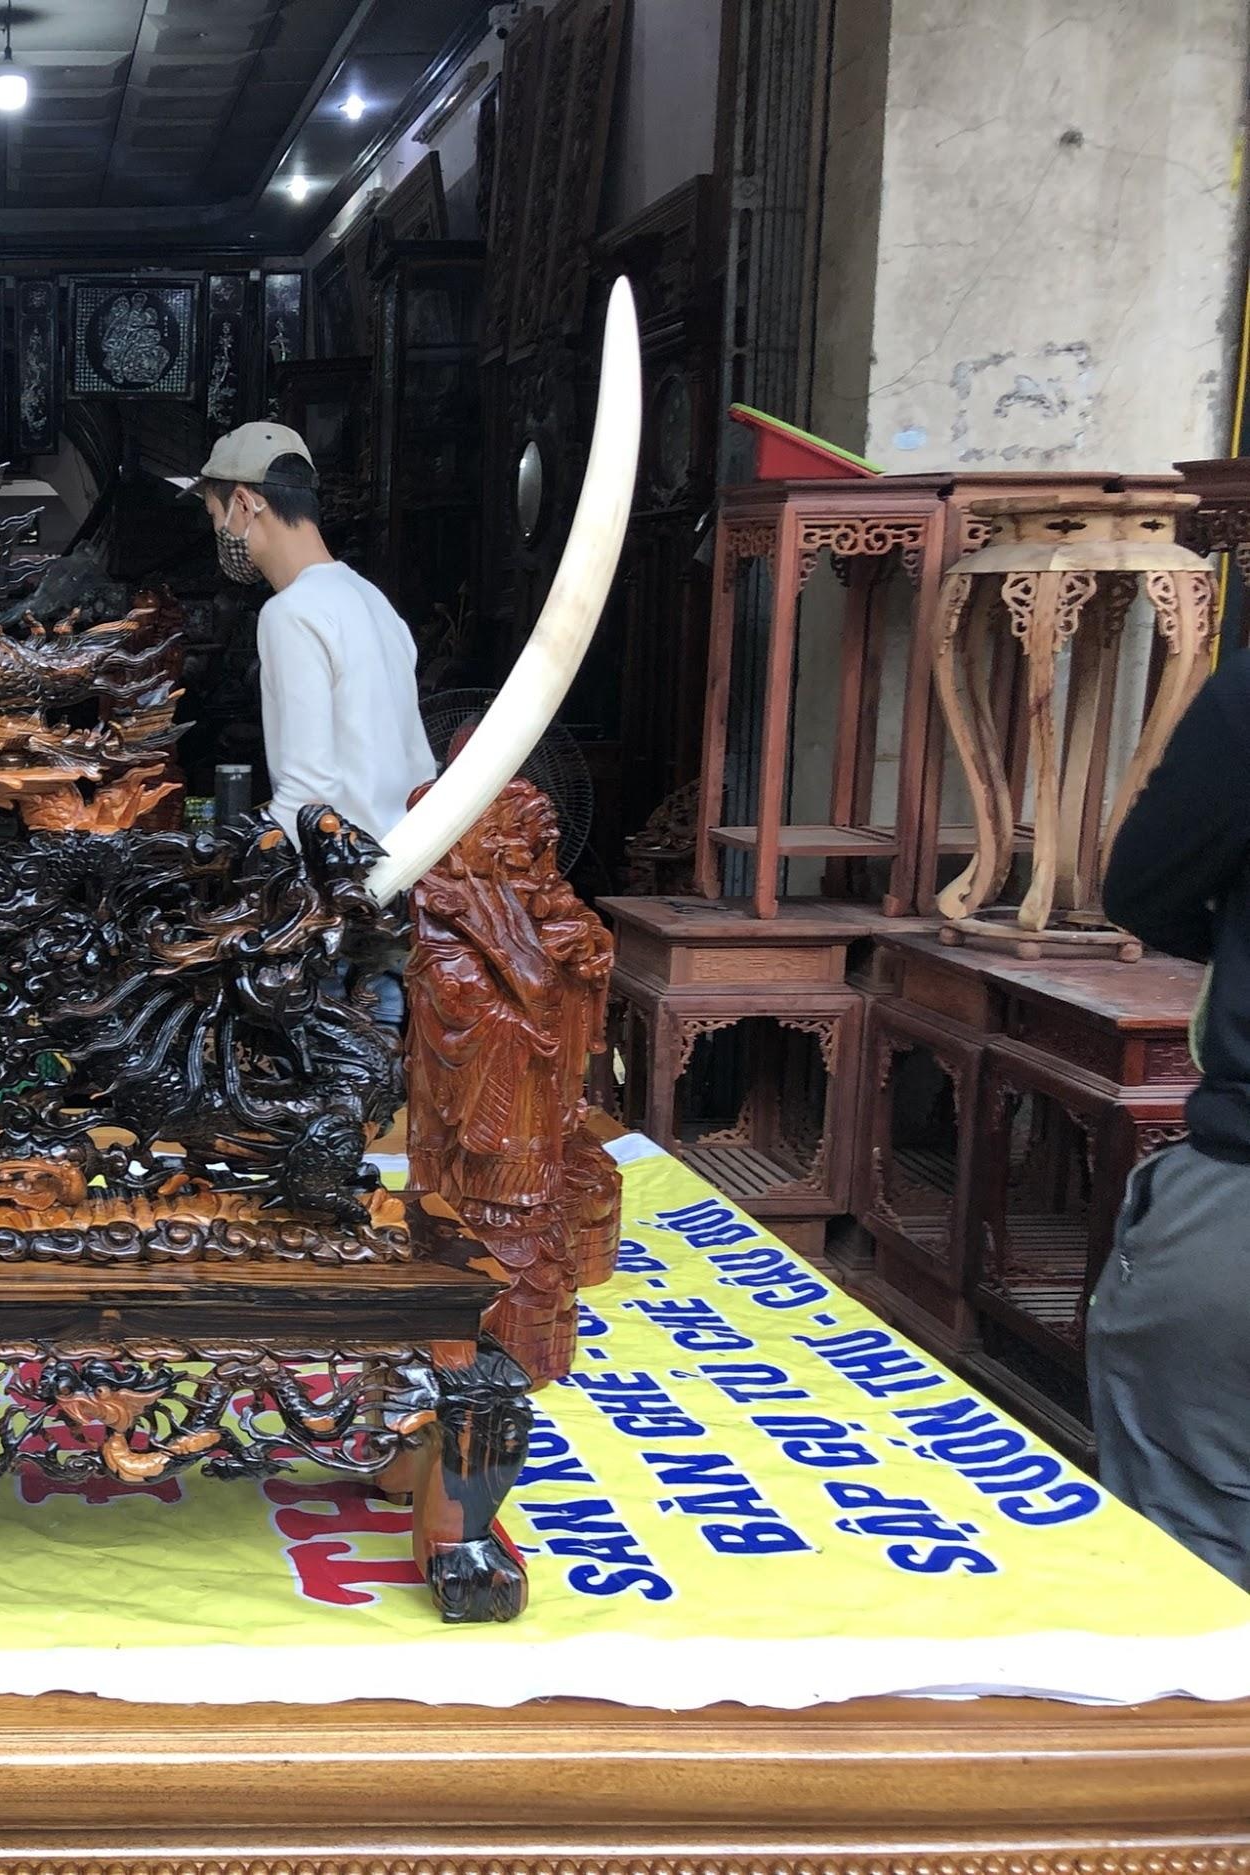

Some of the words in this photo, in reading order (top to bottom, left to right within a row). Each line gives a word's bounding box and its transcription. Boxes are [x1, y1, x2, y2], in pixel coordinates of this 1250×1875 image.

[638, 1199, 759, 1248] ĐỐI
[708, 1248, 829, 1309] CÂU
[621, 1298, 754, 1352] CHÈ
[670, 1363, 812, 1402] TỦ
[791, 1330, 946, 1398] THƯ
[750, 1415, 879, 1467] GỤ
[887, 1397, 1101, 1526] CUỐN
[642, 1452, 813, 1553] BÀN
[823, 1481, 998, 1574] SẬP
